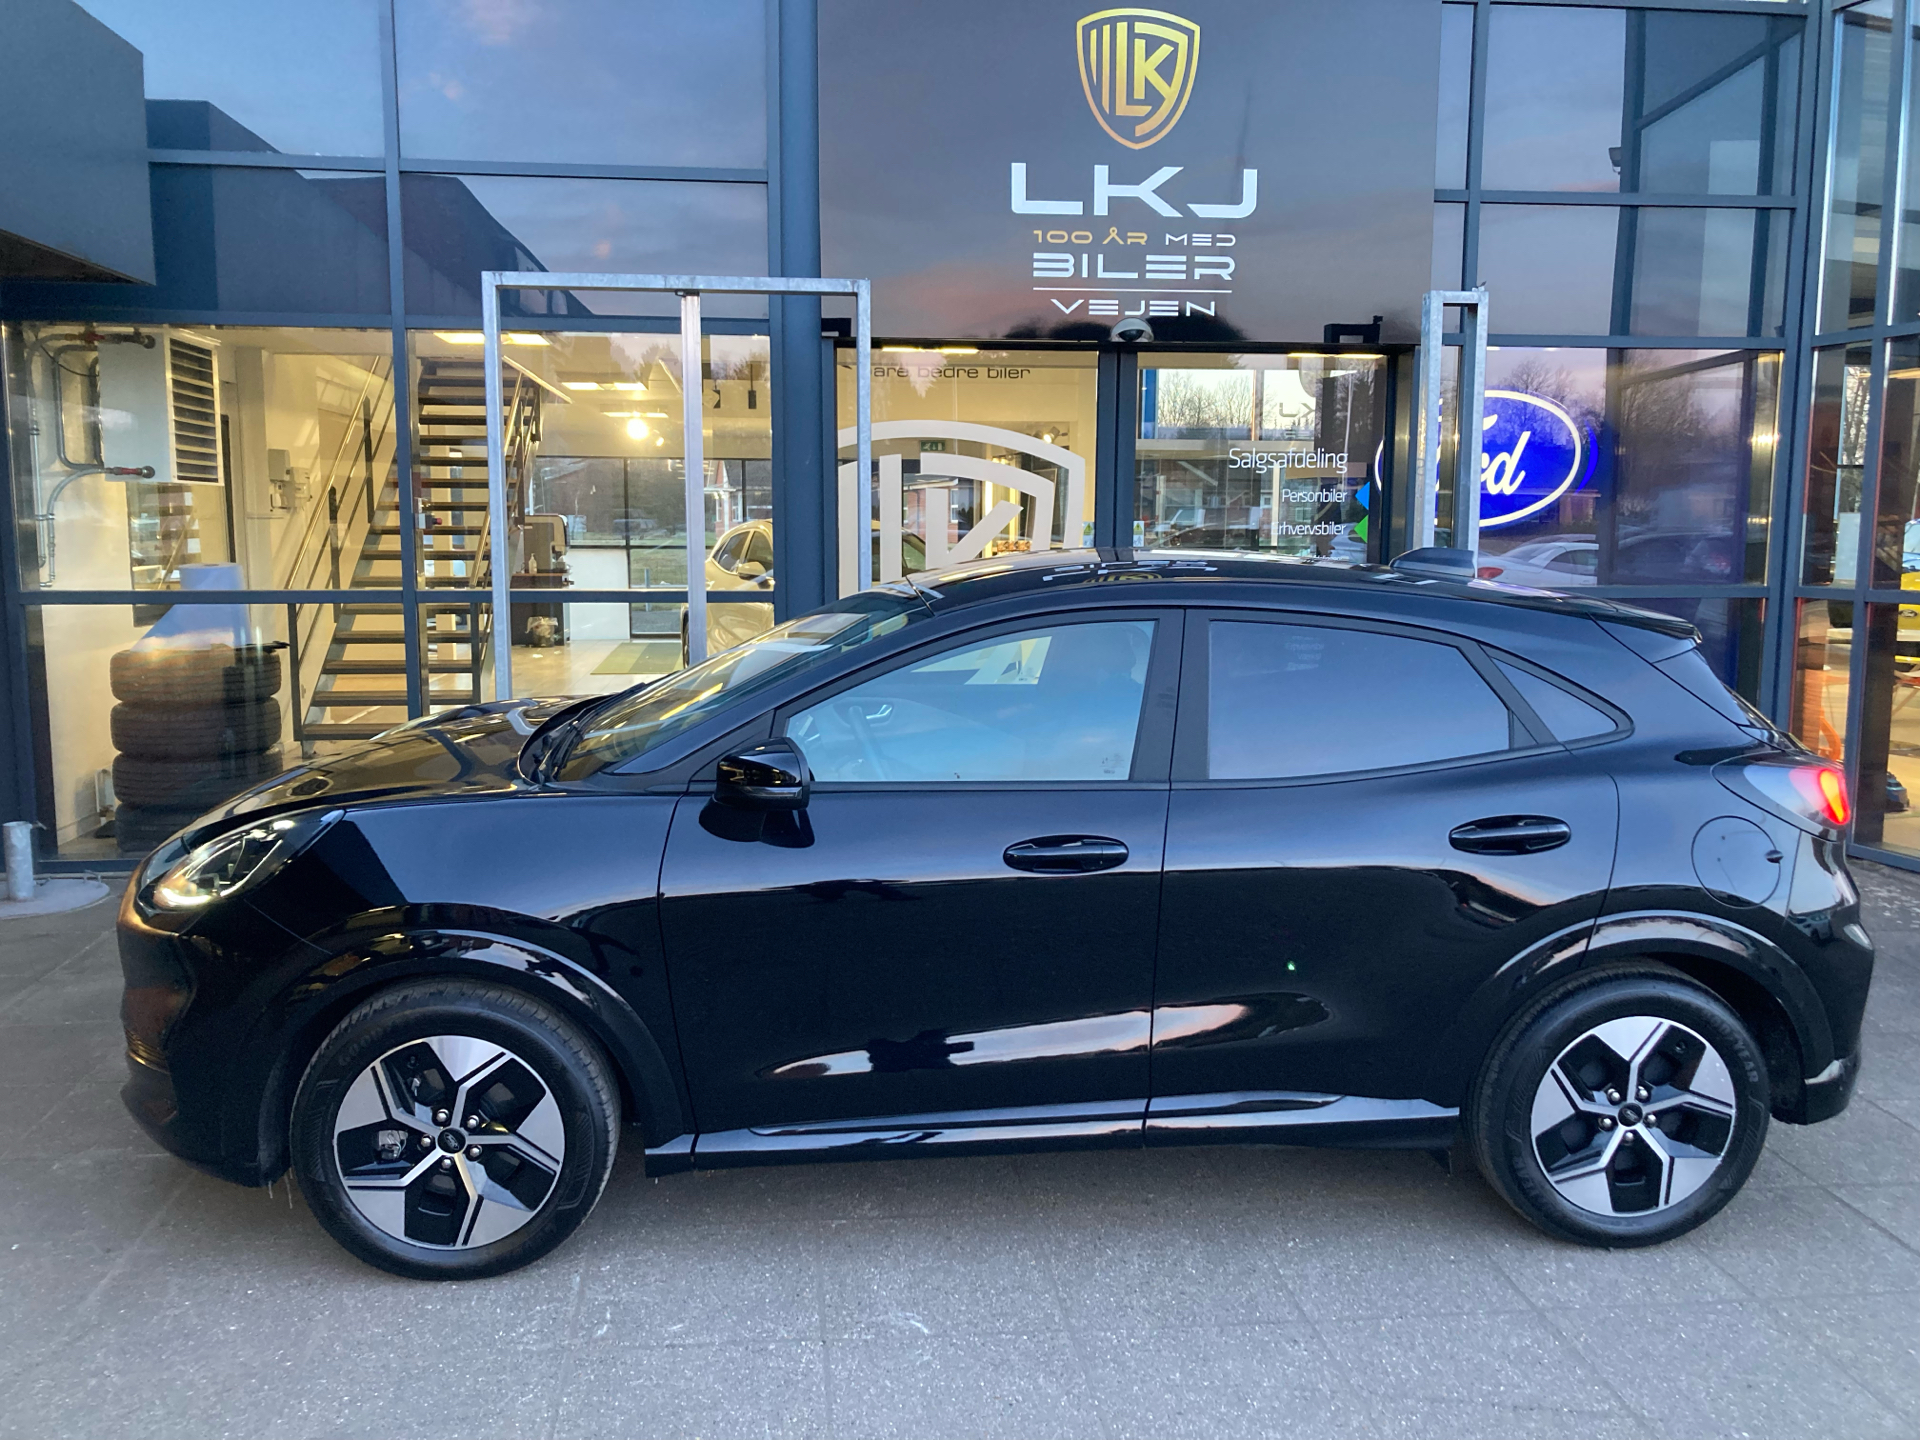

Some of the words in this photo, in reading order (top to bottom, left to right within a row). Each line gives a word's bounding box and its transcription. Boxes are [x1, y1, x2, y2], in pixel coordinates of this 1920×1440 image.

[1010, 162, 1258, 218] LKJ
[1033, 229, 1093, 244] 100
[1102, 226, 1148, 245] ÅR
[1165, 233, 1236, 247] MED
[1032, 252, 1236, 281] BILER
[1049, 298, 1216, 317] VEJEN
[871, 365, 909, 378] are
[917, 364, 979, 379] bedre
[987, 365, 1031, 379] biler
[1228, 447, 1349, 474] Salgsafdeling
[1282, 488, 1348, 503] Personbiler
